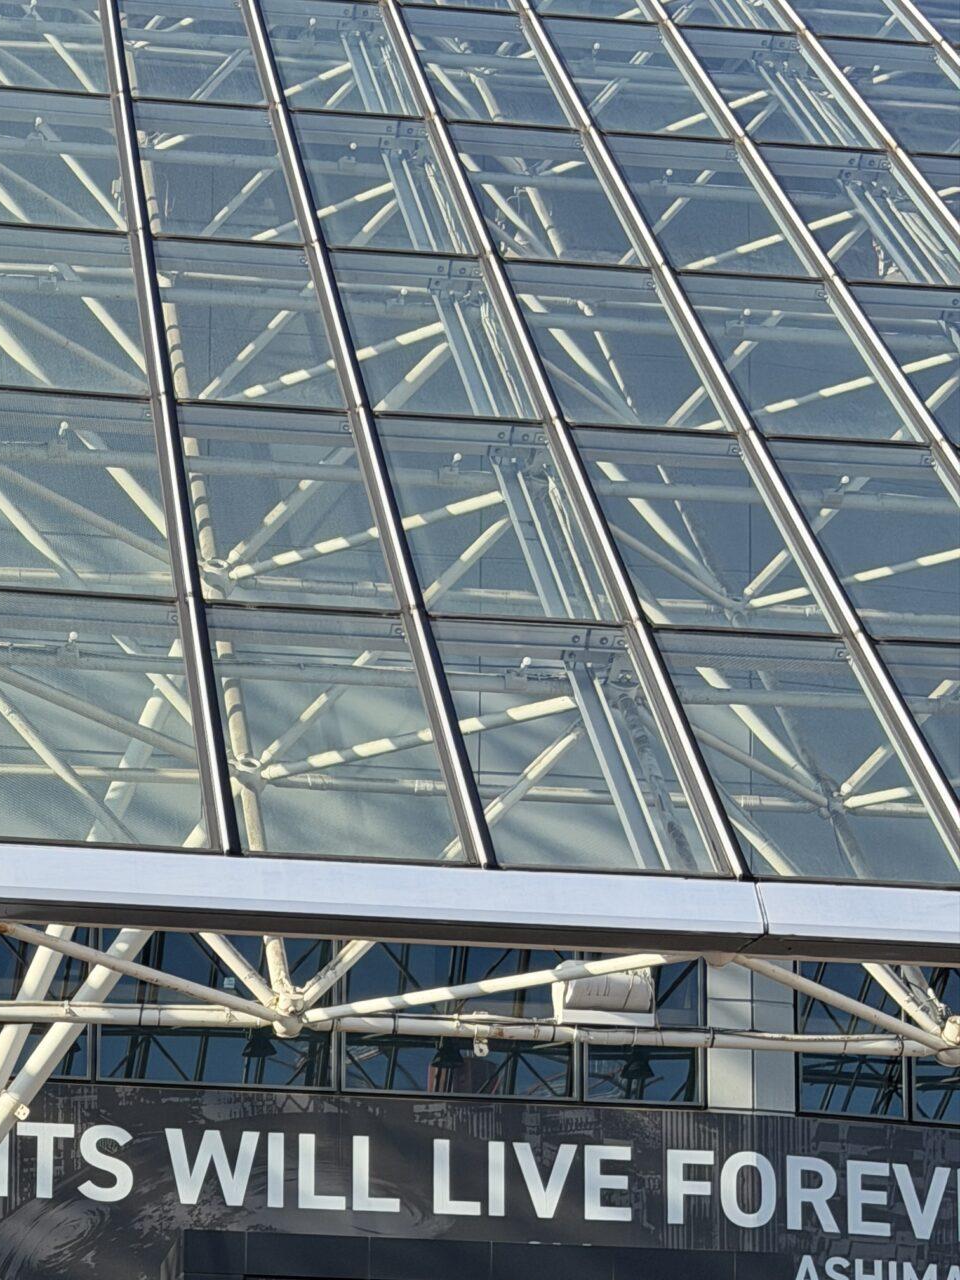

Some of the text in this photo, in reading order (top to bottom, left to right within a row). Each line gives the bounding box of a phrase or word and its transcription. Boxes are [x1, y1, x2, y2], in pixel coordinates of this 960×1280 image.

[165, 1128, 400, 1214] WILL
[433, 1138, 632, 1222] LIVE
[665, 1148, 960, 1242] FOREV
